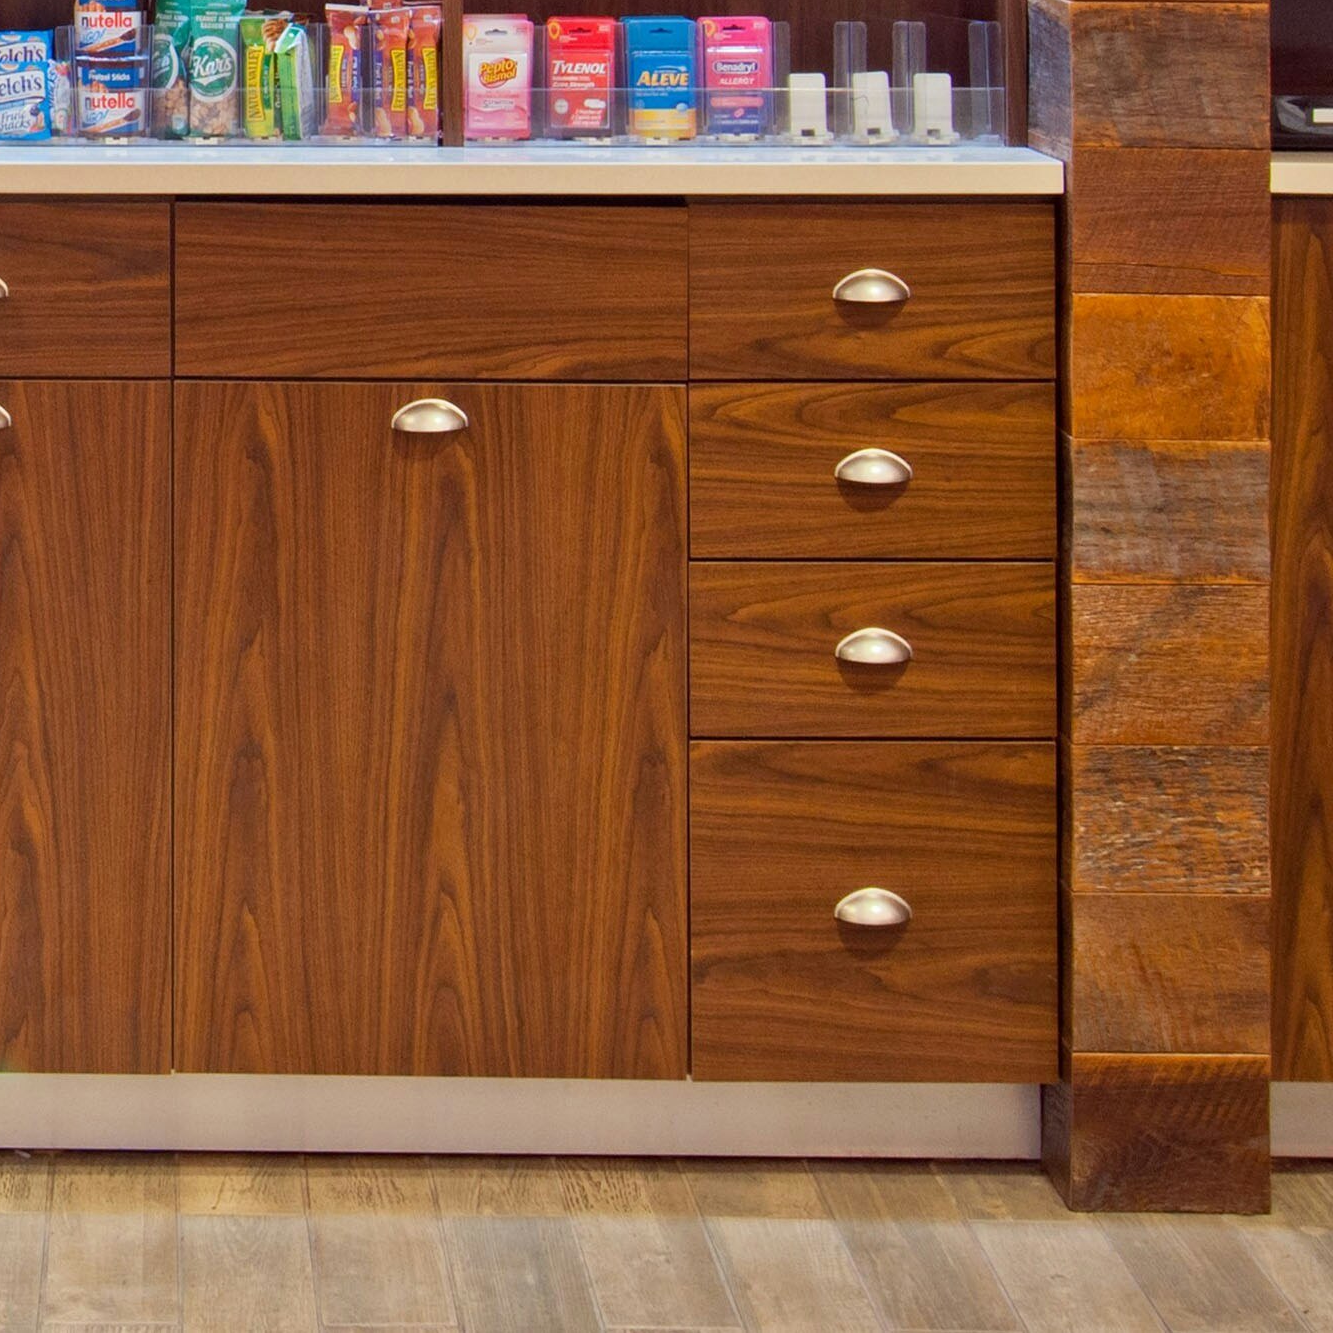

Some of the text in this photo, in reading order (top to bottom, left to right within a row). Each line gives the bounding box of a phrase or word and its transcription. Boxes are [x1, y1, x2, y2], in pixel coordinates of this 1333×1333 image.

[81, 11, 133, 28] nutella
[552, 59, 606, 75] TYLENOL
[716, 62, 757, 75] Benadryl
[483, 68, 517, 84] Bismol
[637, 70, 690, 86] ALEVE
[719, 77, 755, 85] ALLERGY
[84, 92, 135, 109] nutella
